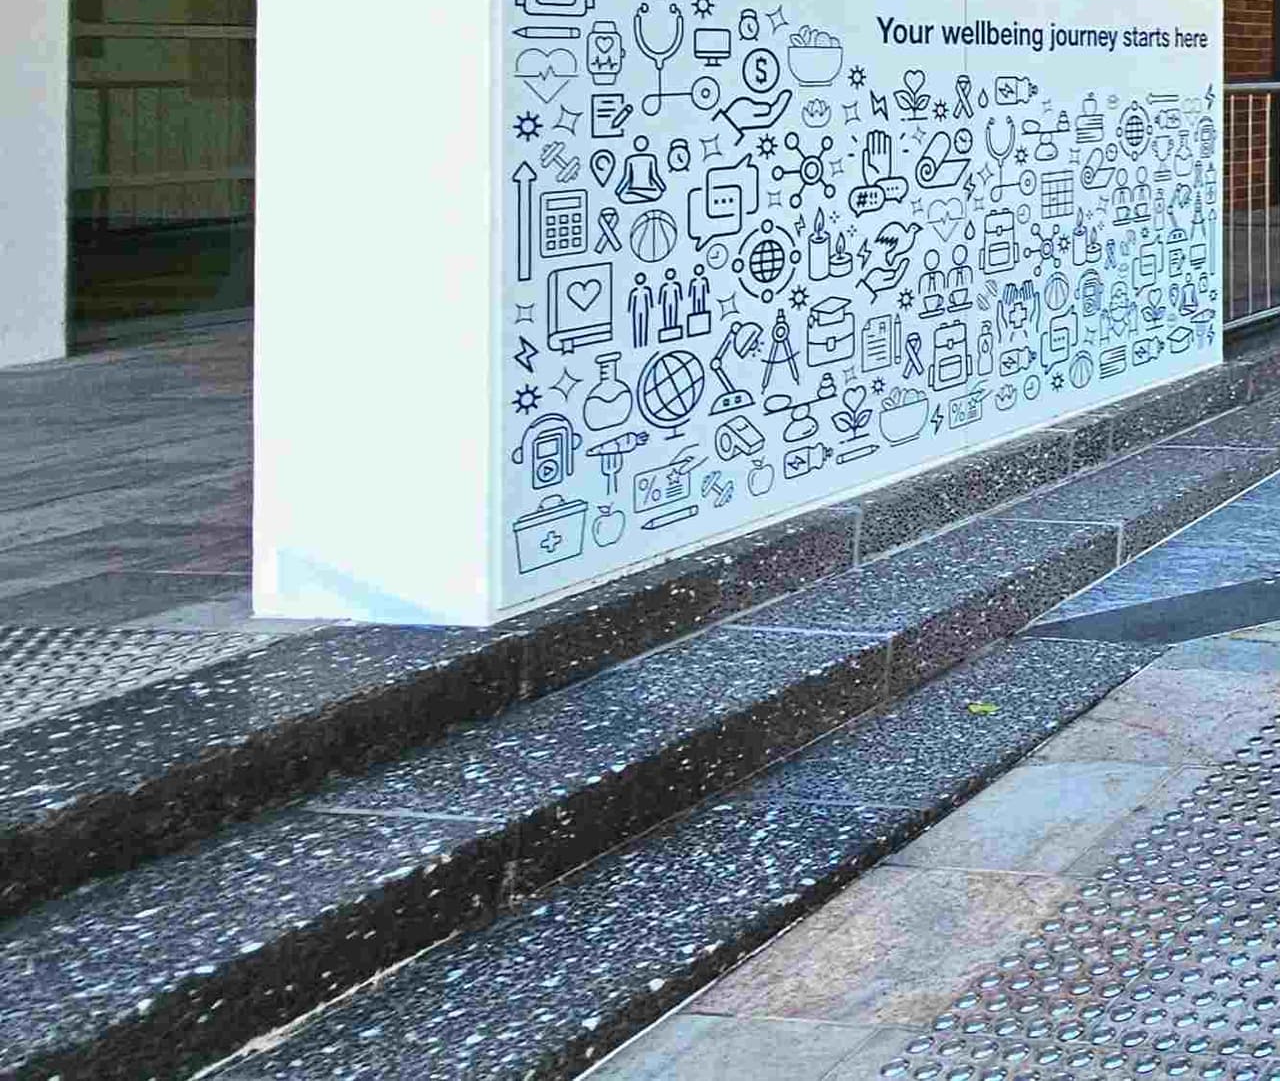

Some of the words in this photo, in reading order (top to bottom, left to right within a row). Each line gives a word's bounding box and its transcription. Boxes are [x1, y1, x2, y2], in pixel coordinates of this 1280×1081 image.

[876, 16, 935, 45] Your
[941, 20, 1044, 53] wellbeing
[1049, 23, 1118, 53] journey
[1122, 27, 1170, 48] starts
[1174, 28, 1207, 48] here
